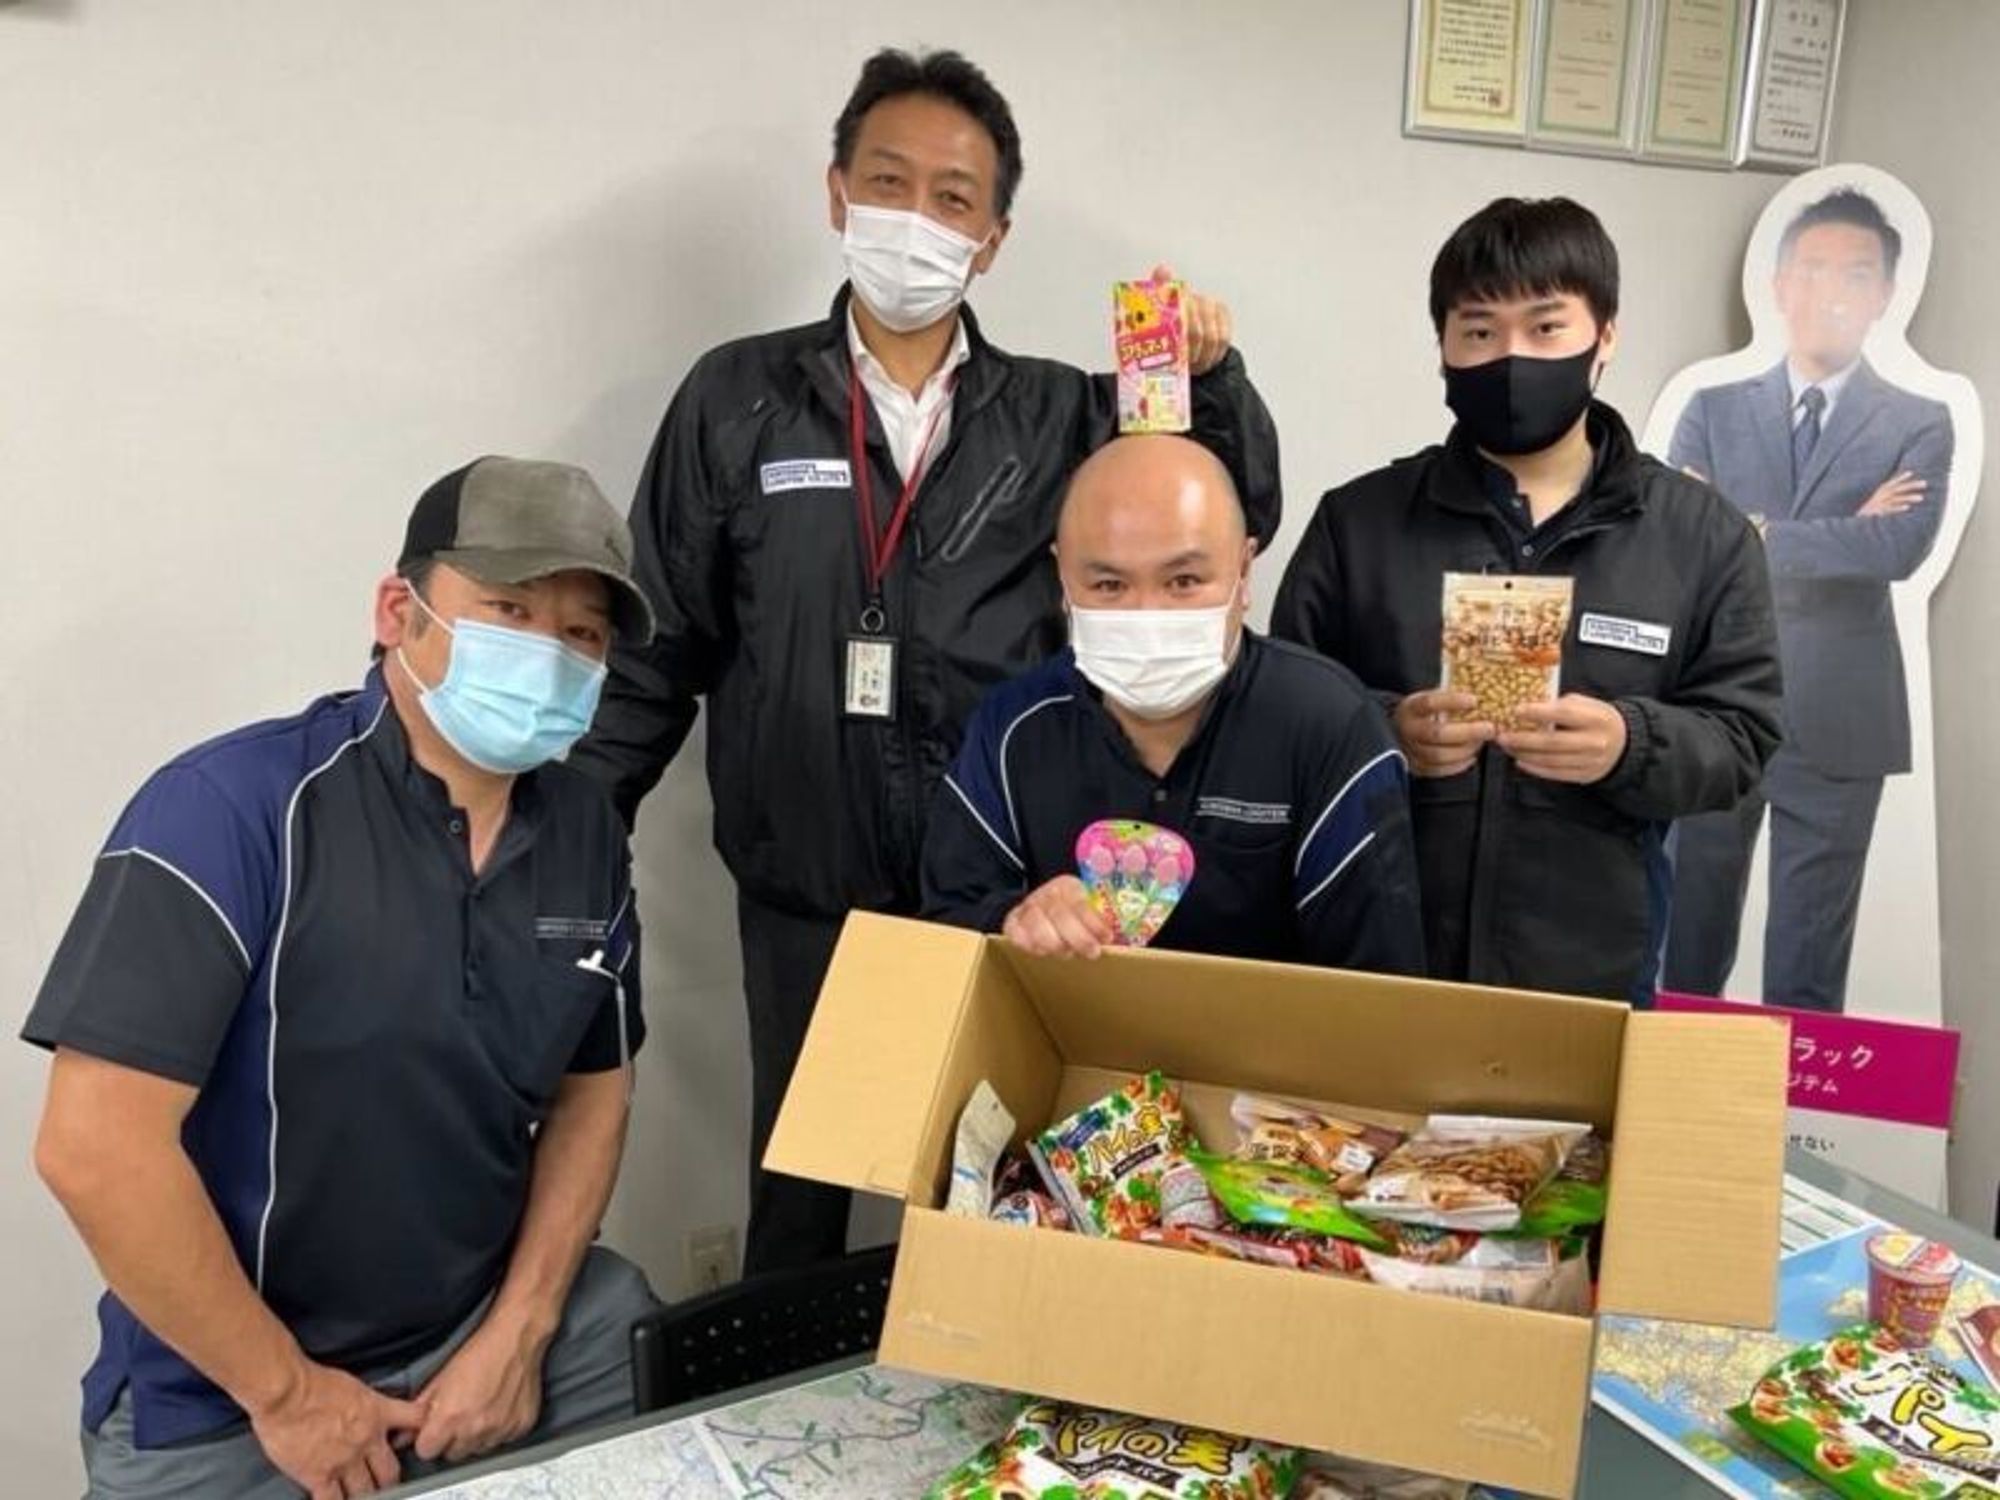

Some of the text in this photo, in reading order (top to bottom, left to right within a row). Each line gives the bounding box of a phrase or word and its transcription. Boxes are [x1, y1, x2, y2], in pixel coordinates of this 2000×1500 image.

[1793, 1036, 1874, 1069] ラック
[1026, 1403, 1240, 1475] パイの実
